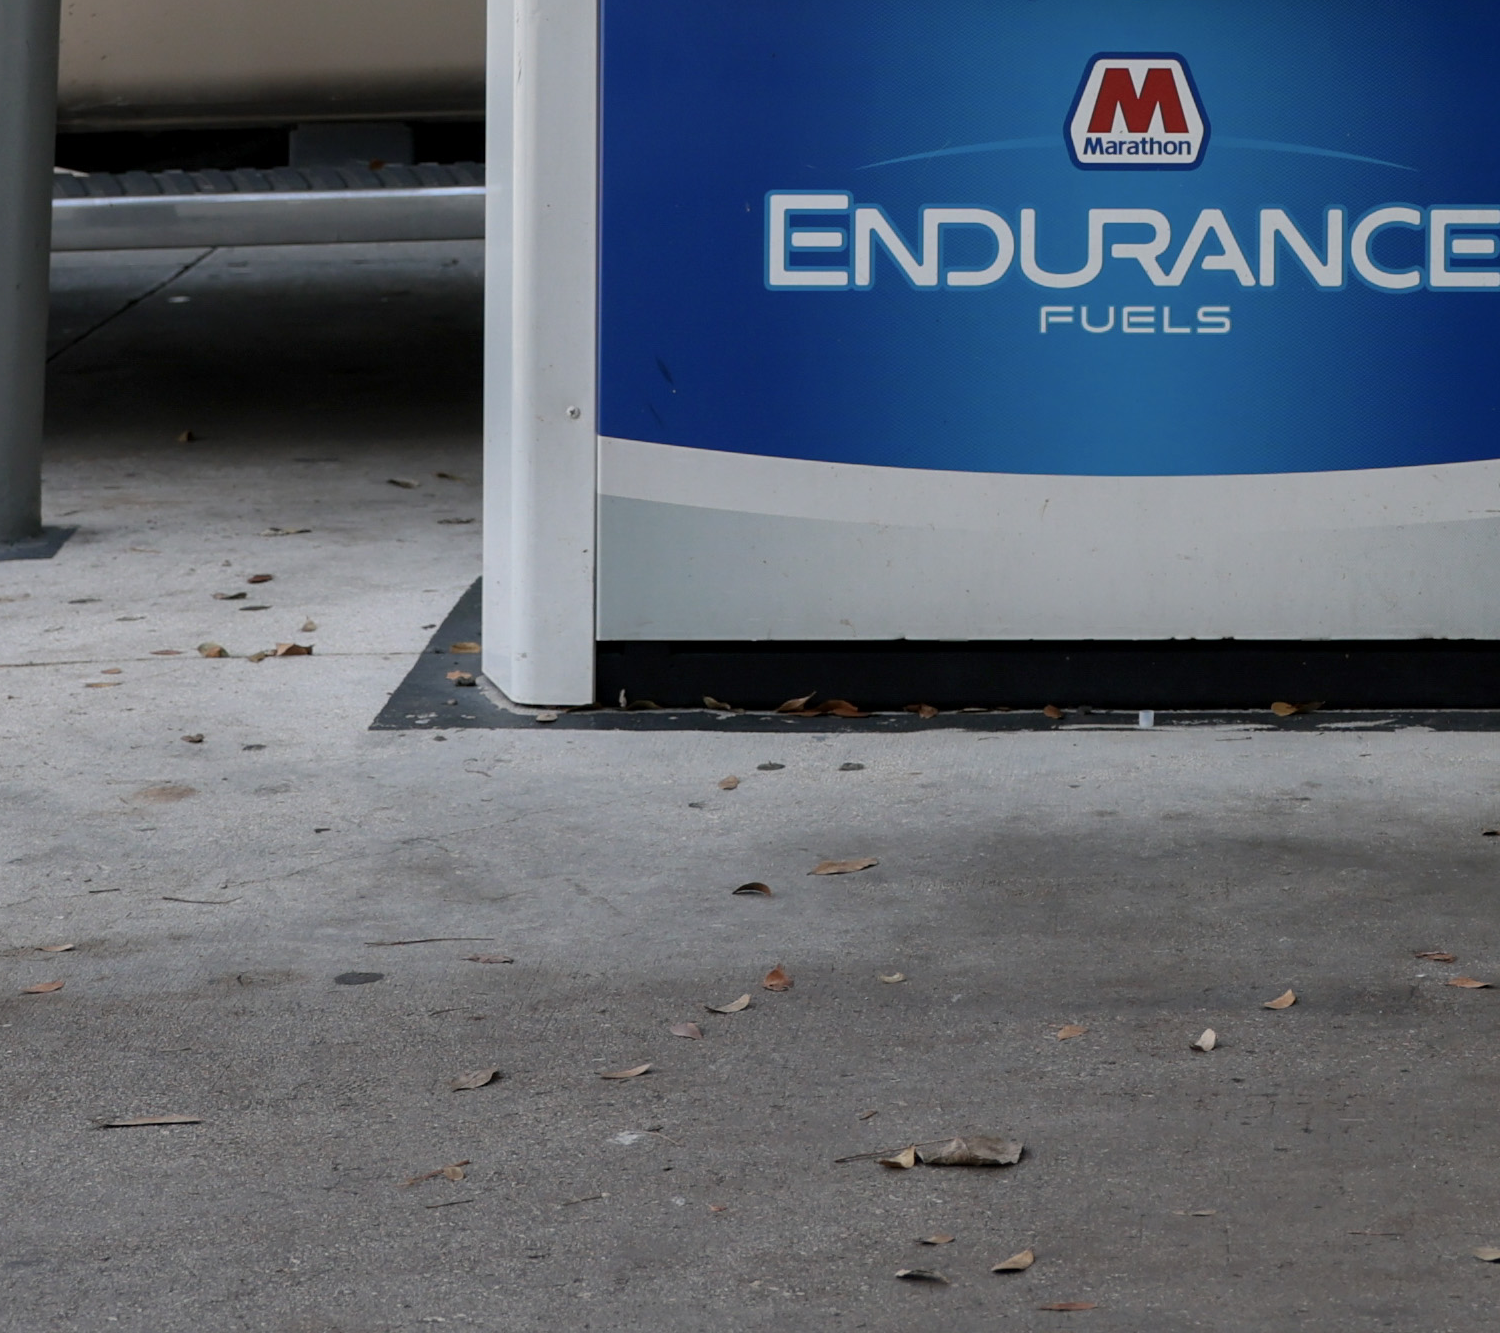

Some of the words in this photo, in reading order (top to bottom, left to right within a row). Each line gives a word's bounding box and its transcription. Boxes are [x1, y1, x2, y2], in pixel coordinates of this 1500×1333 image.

[1088, 68, 1189, 133] M
[1083, 137, 1191, 155] Marathon
[769, 194, 1500, 289] ENDURANCE
[1040, 306, 1230, 333] FUELS
